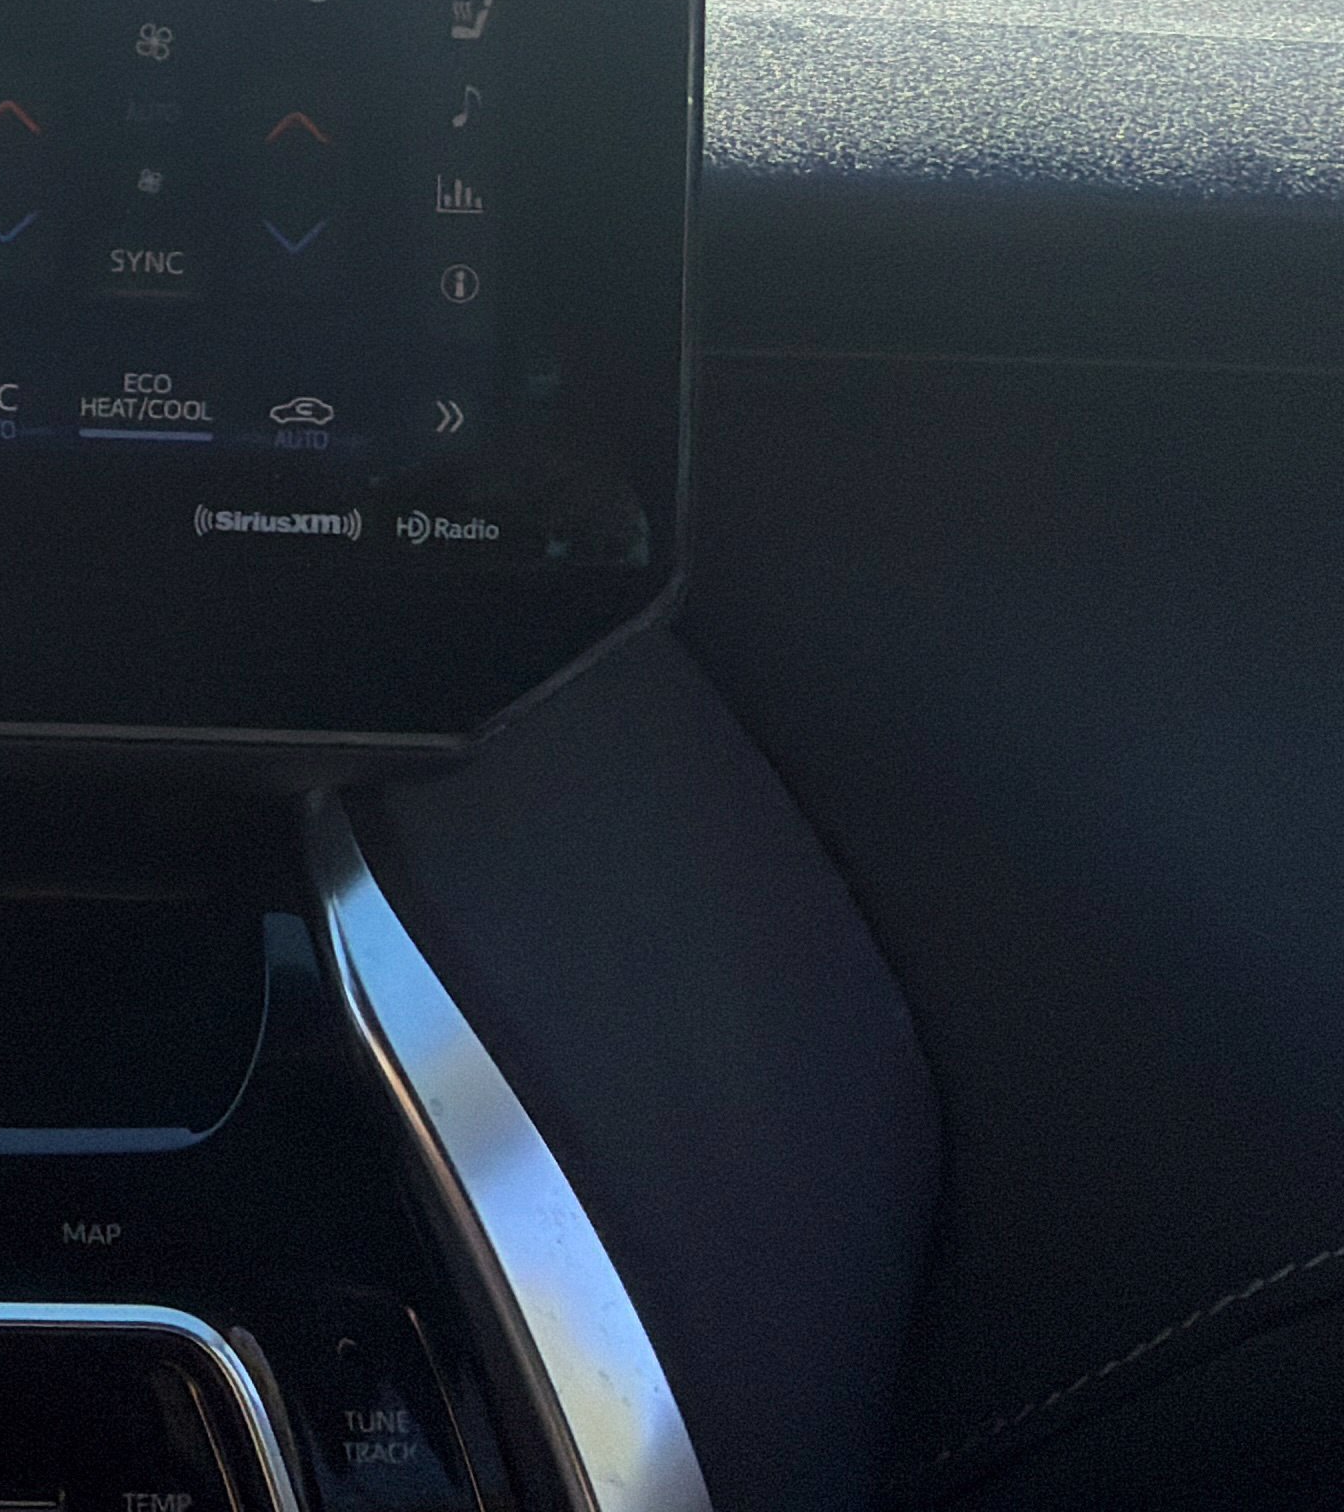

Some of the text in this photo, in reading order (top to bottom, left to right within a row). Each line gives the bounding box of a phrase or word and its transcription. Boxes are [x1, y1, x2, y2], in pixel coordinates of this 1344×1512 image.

[110, 249, 185, 276] SYNC
[122, 372, 173, 396] ECO
[78, 396, 214, 423] HEAT/COOL
[273, 430, 330, 452] AUTO
[434, 516, 501, 542] Radio
[61, 1221, 122, 1248] MAP
[343, 1408, 412, 1436] TUNE
[342, 1441, 420, 1467] TRACK
[122, 1491, 193, 1512] TEMP
